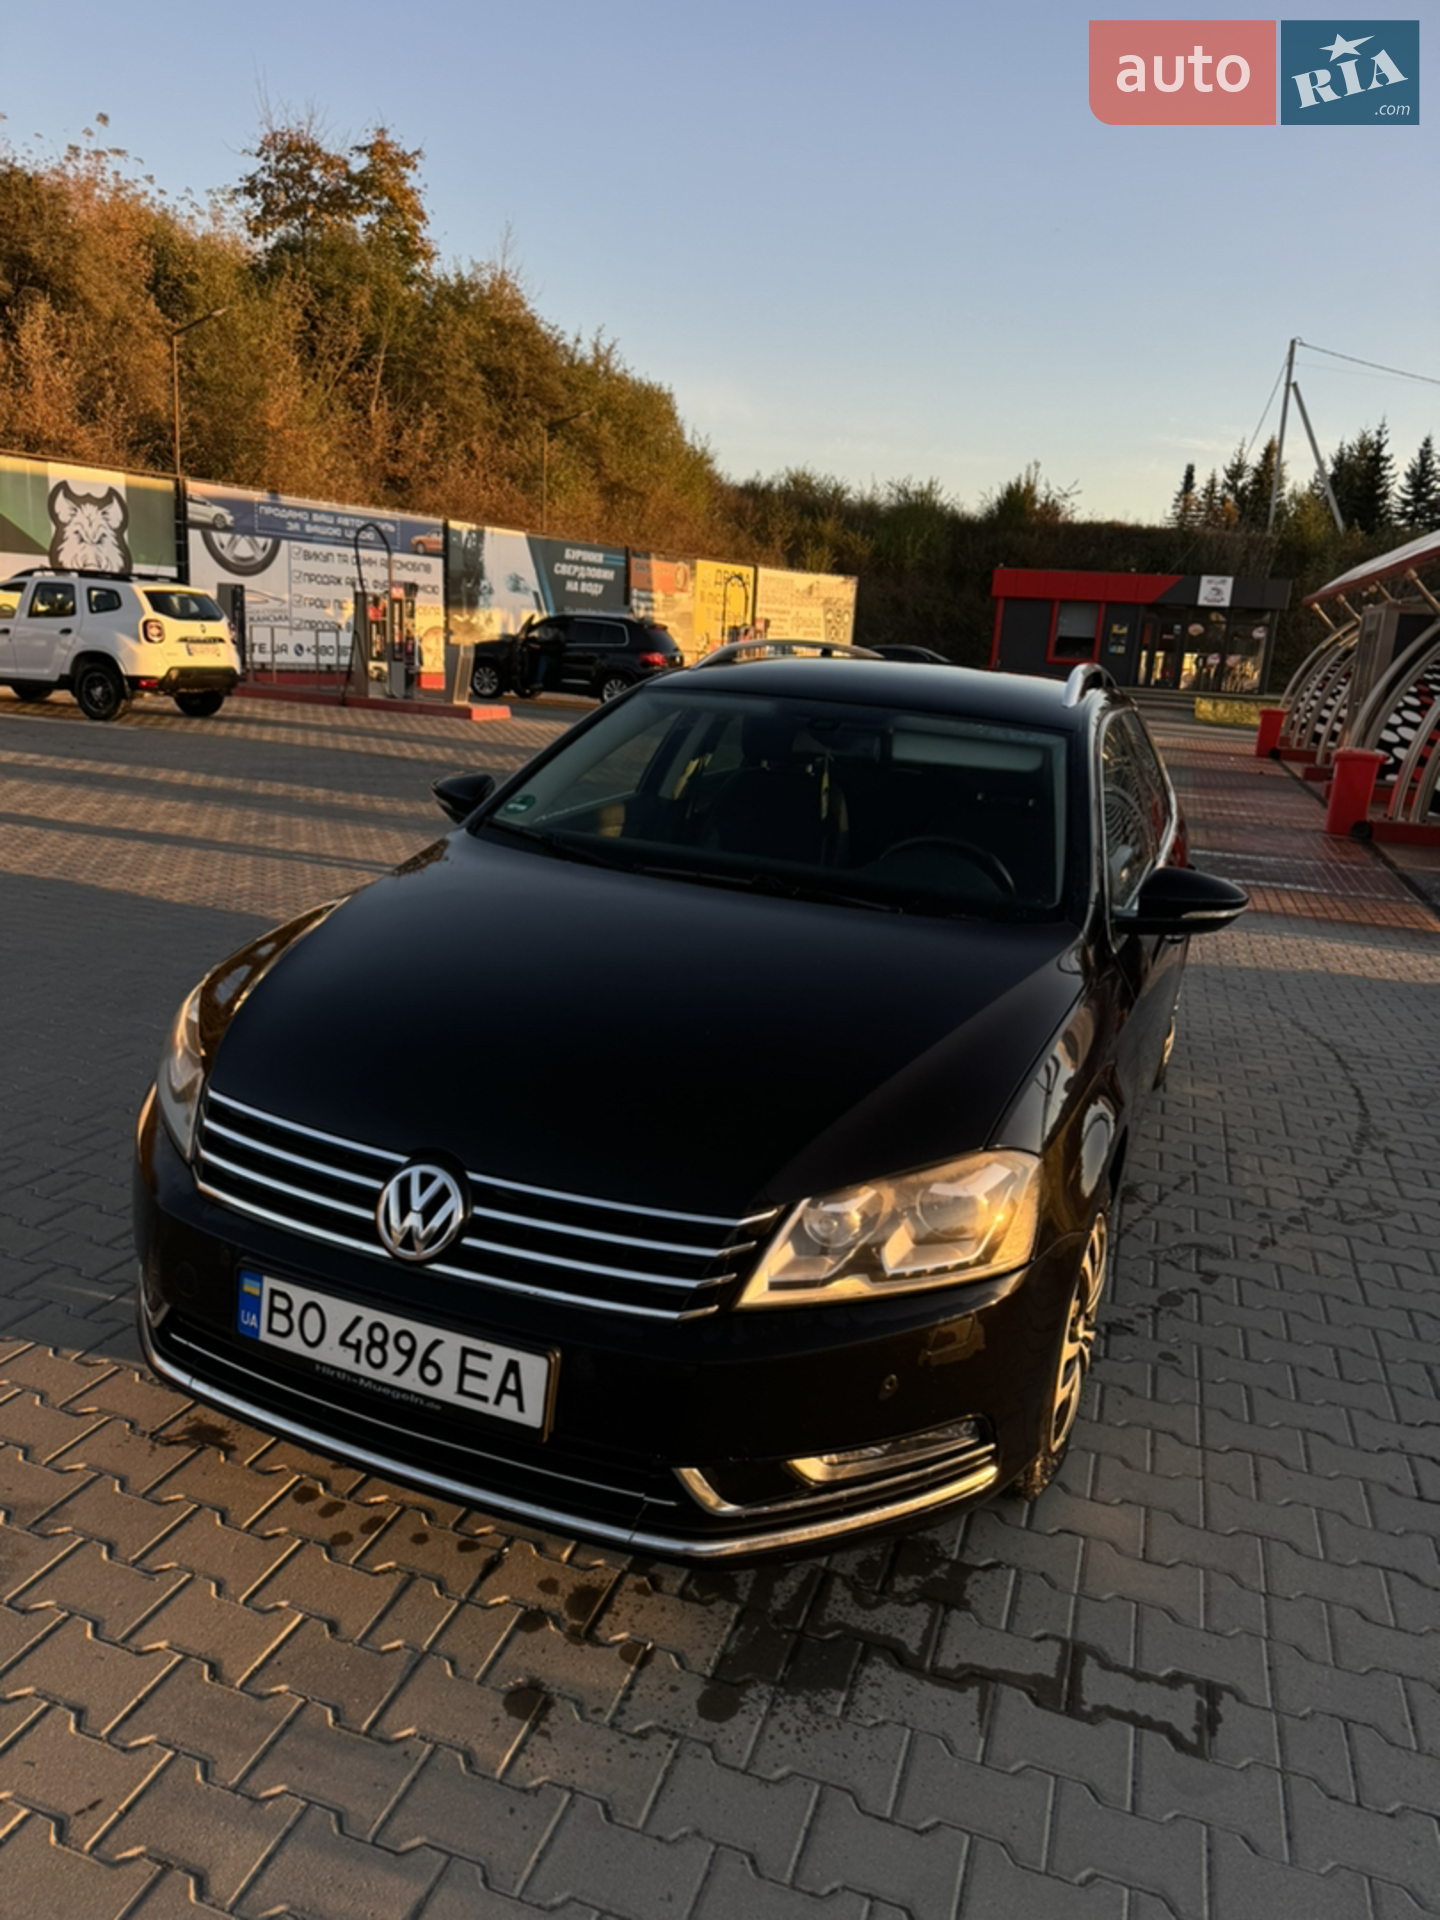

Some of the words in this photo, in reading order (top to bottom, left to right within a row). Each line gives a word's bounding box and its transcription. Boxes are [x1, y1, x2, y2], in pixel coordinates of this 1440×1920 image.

[286, 520, 300, 532] ЗА
[311, 513, 334, 525] ВАШ
[303, 549, 335, 564] ВИКУП
[337, 552, 350, 565] ТА
[351, 554, 378, 569] ОМІН
[565, 579, 579, 593] НА
[580, 581, 604, 597] ВОДУ
[240, 1309, 259, 1329] UA
[266, 1287, 327, 1349] BO
[338, 1315, 446, 1387] 4896
[453, 1345, 526, 1415] EA
